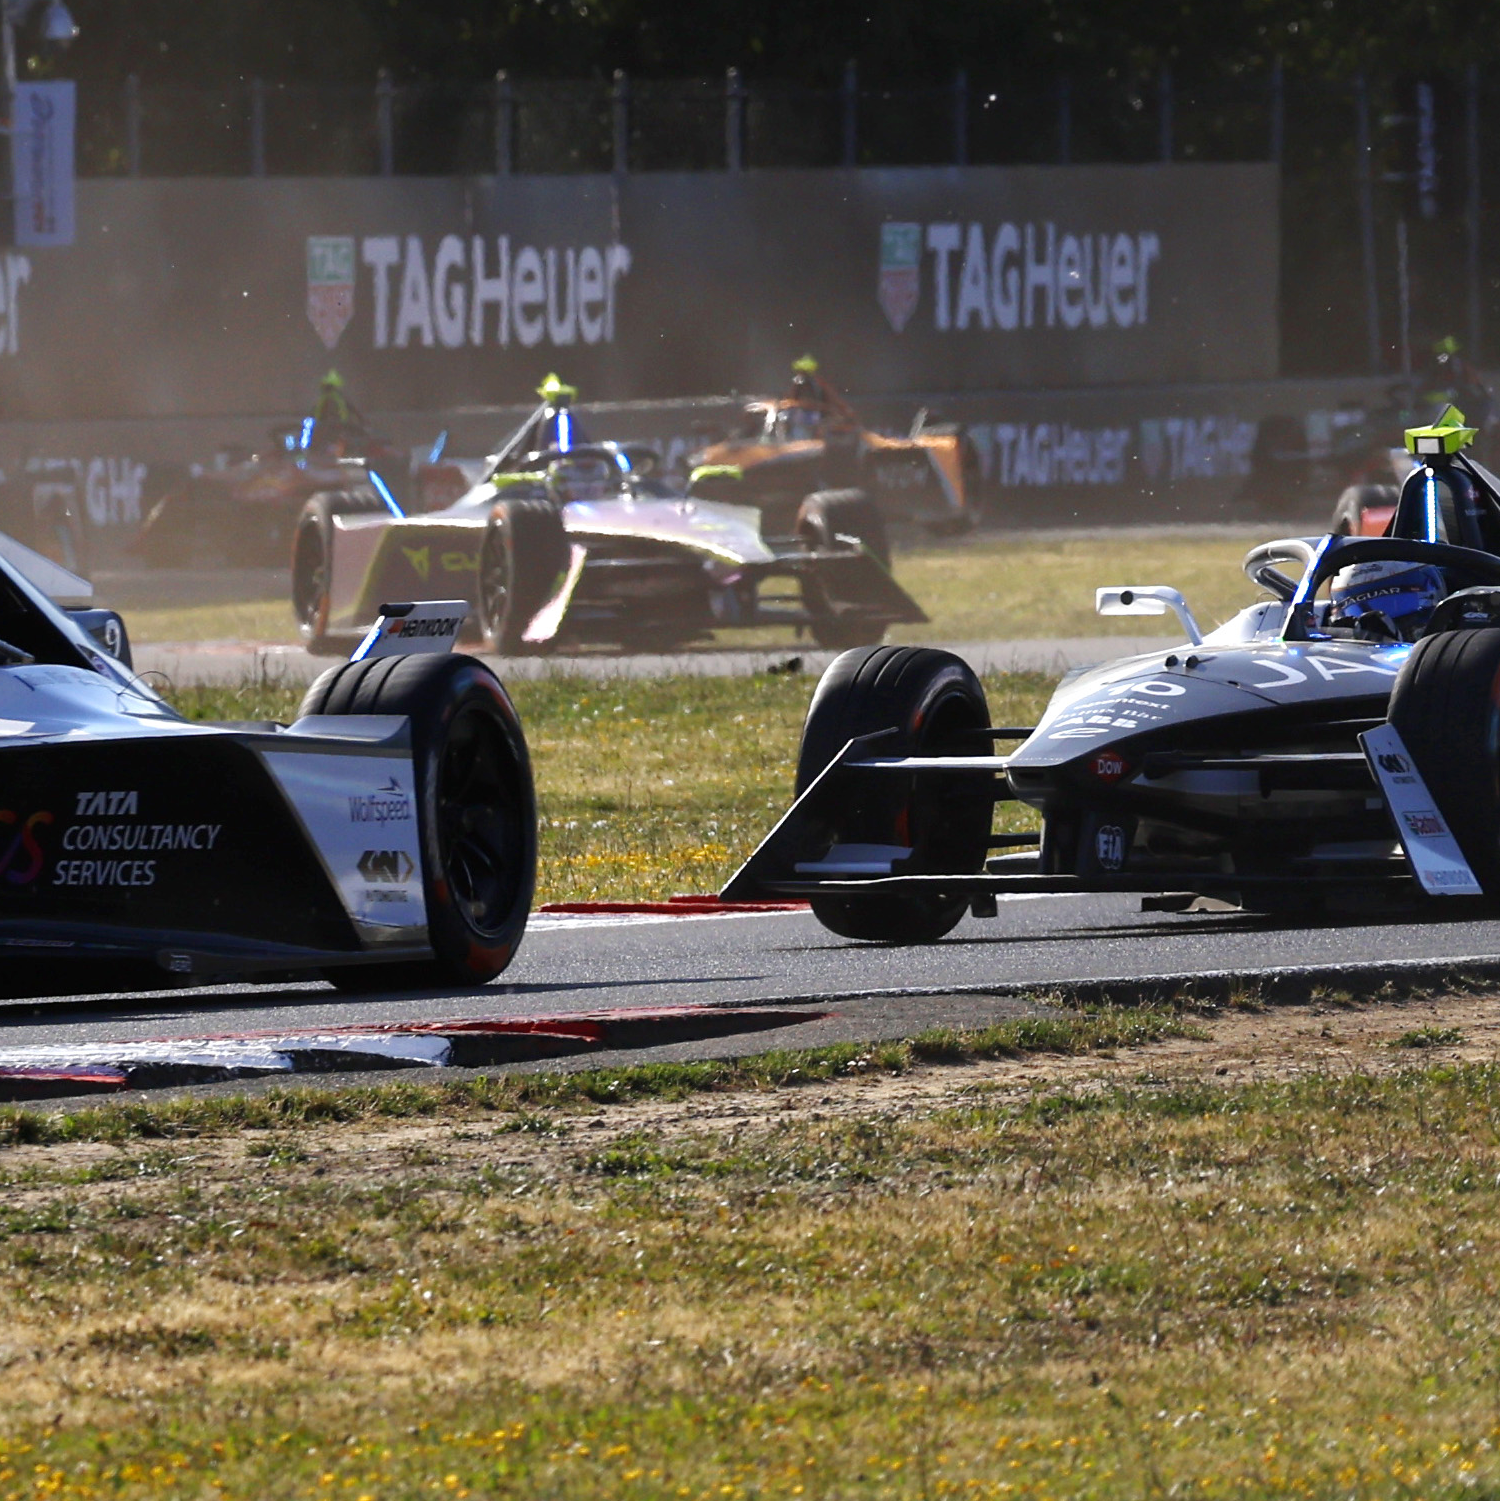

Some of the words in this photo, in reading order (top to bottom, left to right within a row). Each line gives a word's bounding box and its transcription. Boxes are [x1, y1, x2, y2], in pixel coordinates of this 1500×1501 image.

[1341, 586, 1402, 609] JAGUAR
[75, 790, 140, 816] TATA
[350, 795, 411, 827] Wolfspeed
[62, 824, 222, 851] CONSULTANCY
[52, 860, 157, 887] SERVICES
